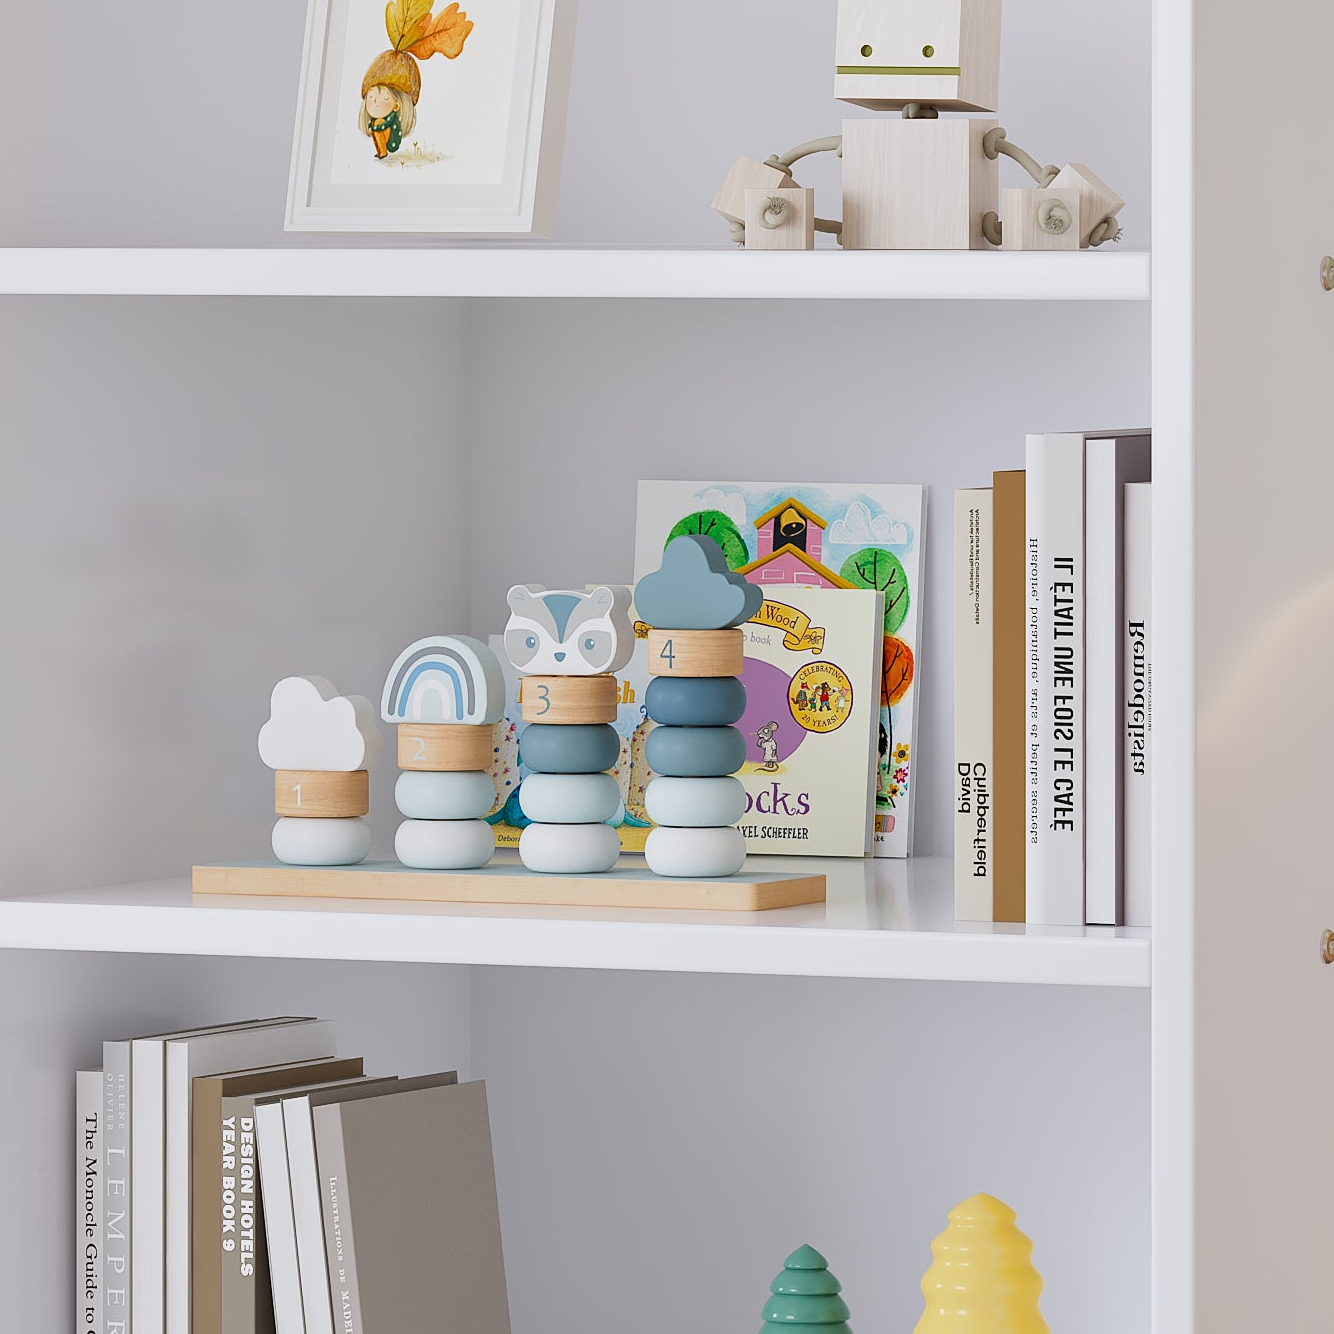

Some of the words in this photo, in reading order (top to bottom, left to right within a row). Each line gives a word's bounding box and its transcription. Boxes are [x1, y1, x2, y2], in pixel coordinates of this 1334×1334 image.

[766, 604, 800, 629] Wood
[750, 631, 772, 645] book
[660, 639, 676, 669] 4
[799, 665, 844, 683] CELEBRATING
[536, 684, 551, 716] 3
[801, 714, 811, 724] 20
[412, 737, 427, 761] 2
[292, 783, 302, 806] 1
[760, 826, 809, 840] SCHEFFLER
[84, 1112, 99, 1149] The
[222, 1116, 236, 1170] YEAR
[240, 1117, 254, 1193] DESIGN
[84, 1156, 99, 1238] Monocle
[222, 1176, 236, 1233] BOOK
[222, 1239, 236, 1252] 9
[240, 1199, 254, 1277] HOTELS
[84, 1243, 99, 1300] Guide
[84, 1307, 98, 1324] to
